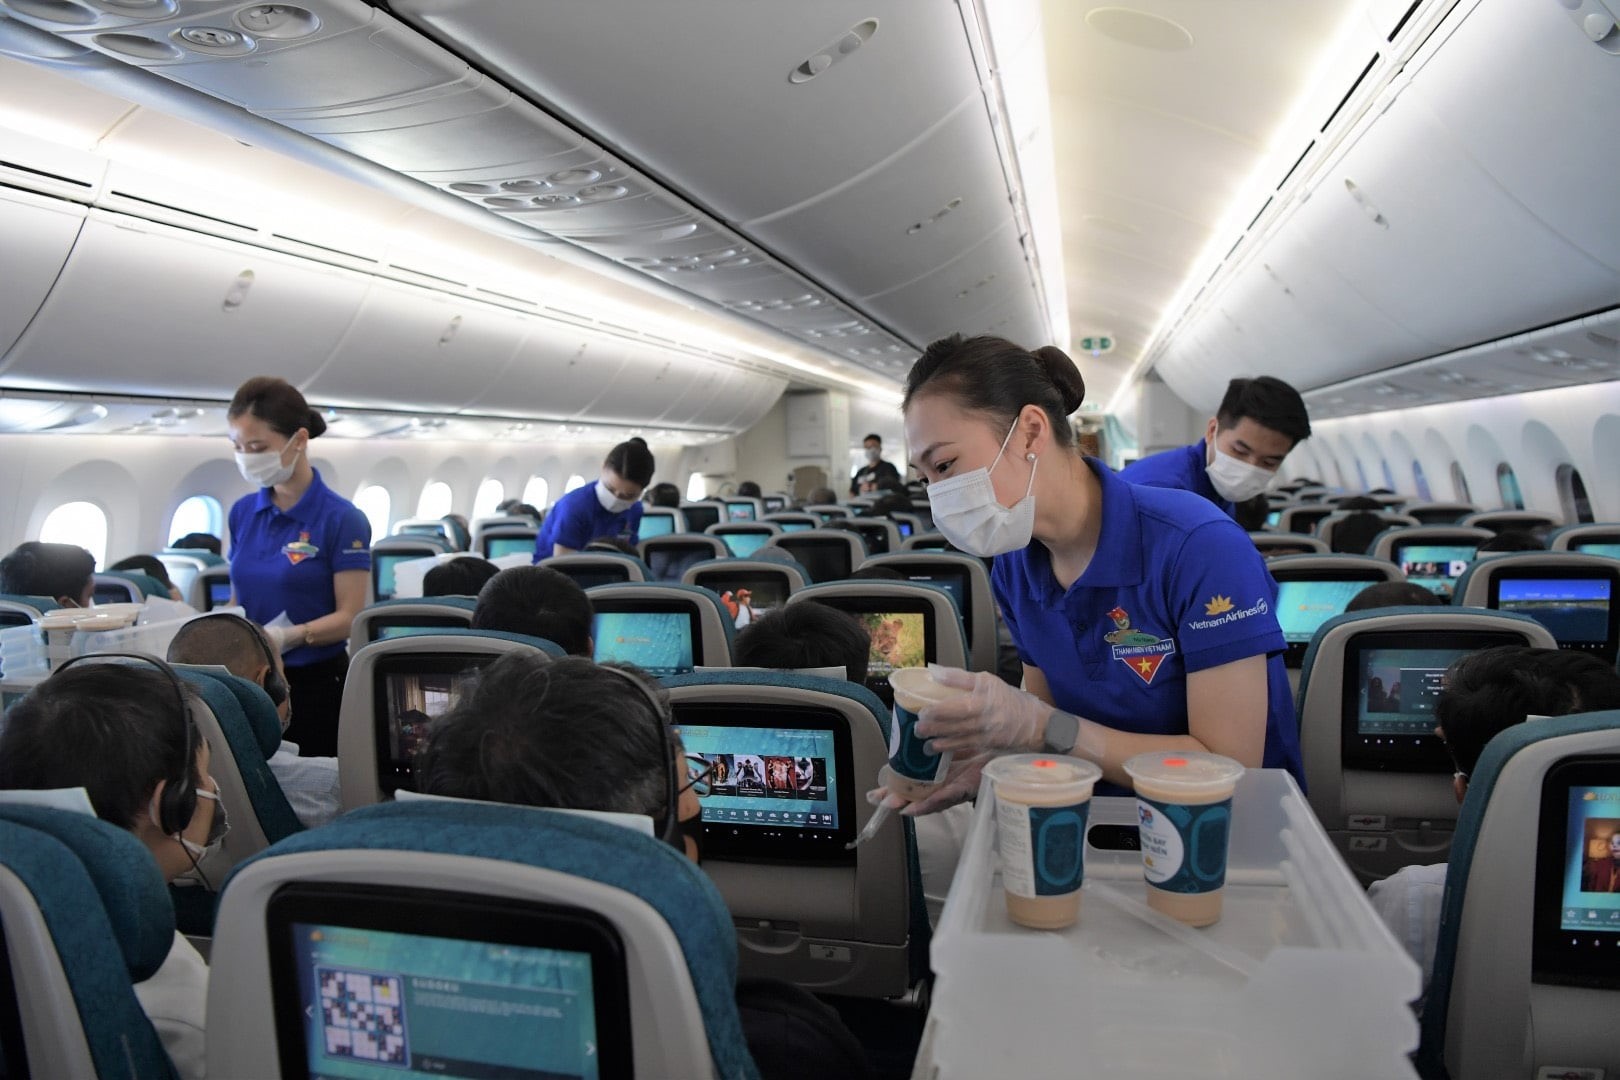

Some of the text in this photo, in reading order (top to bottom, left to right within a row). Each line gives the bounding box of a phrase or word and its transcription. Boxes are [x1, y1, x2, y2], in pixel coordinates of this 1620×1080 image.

[1188, 606, 1257, 630] Vietnam Airlines
[1156, 642, 1171, 651] NAM
